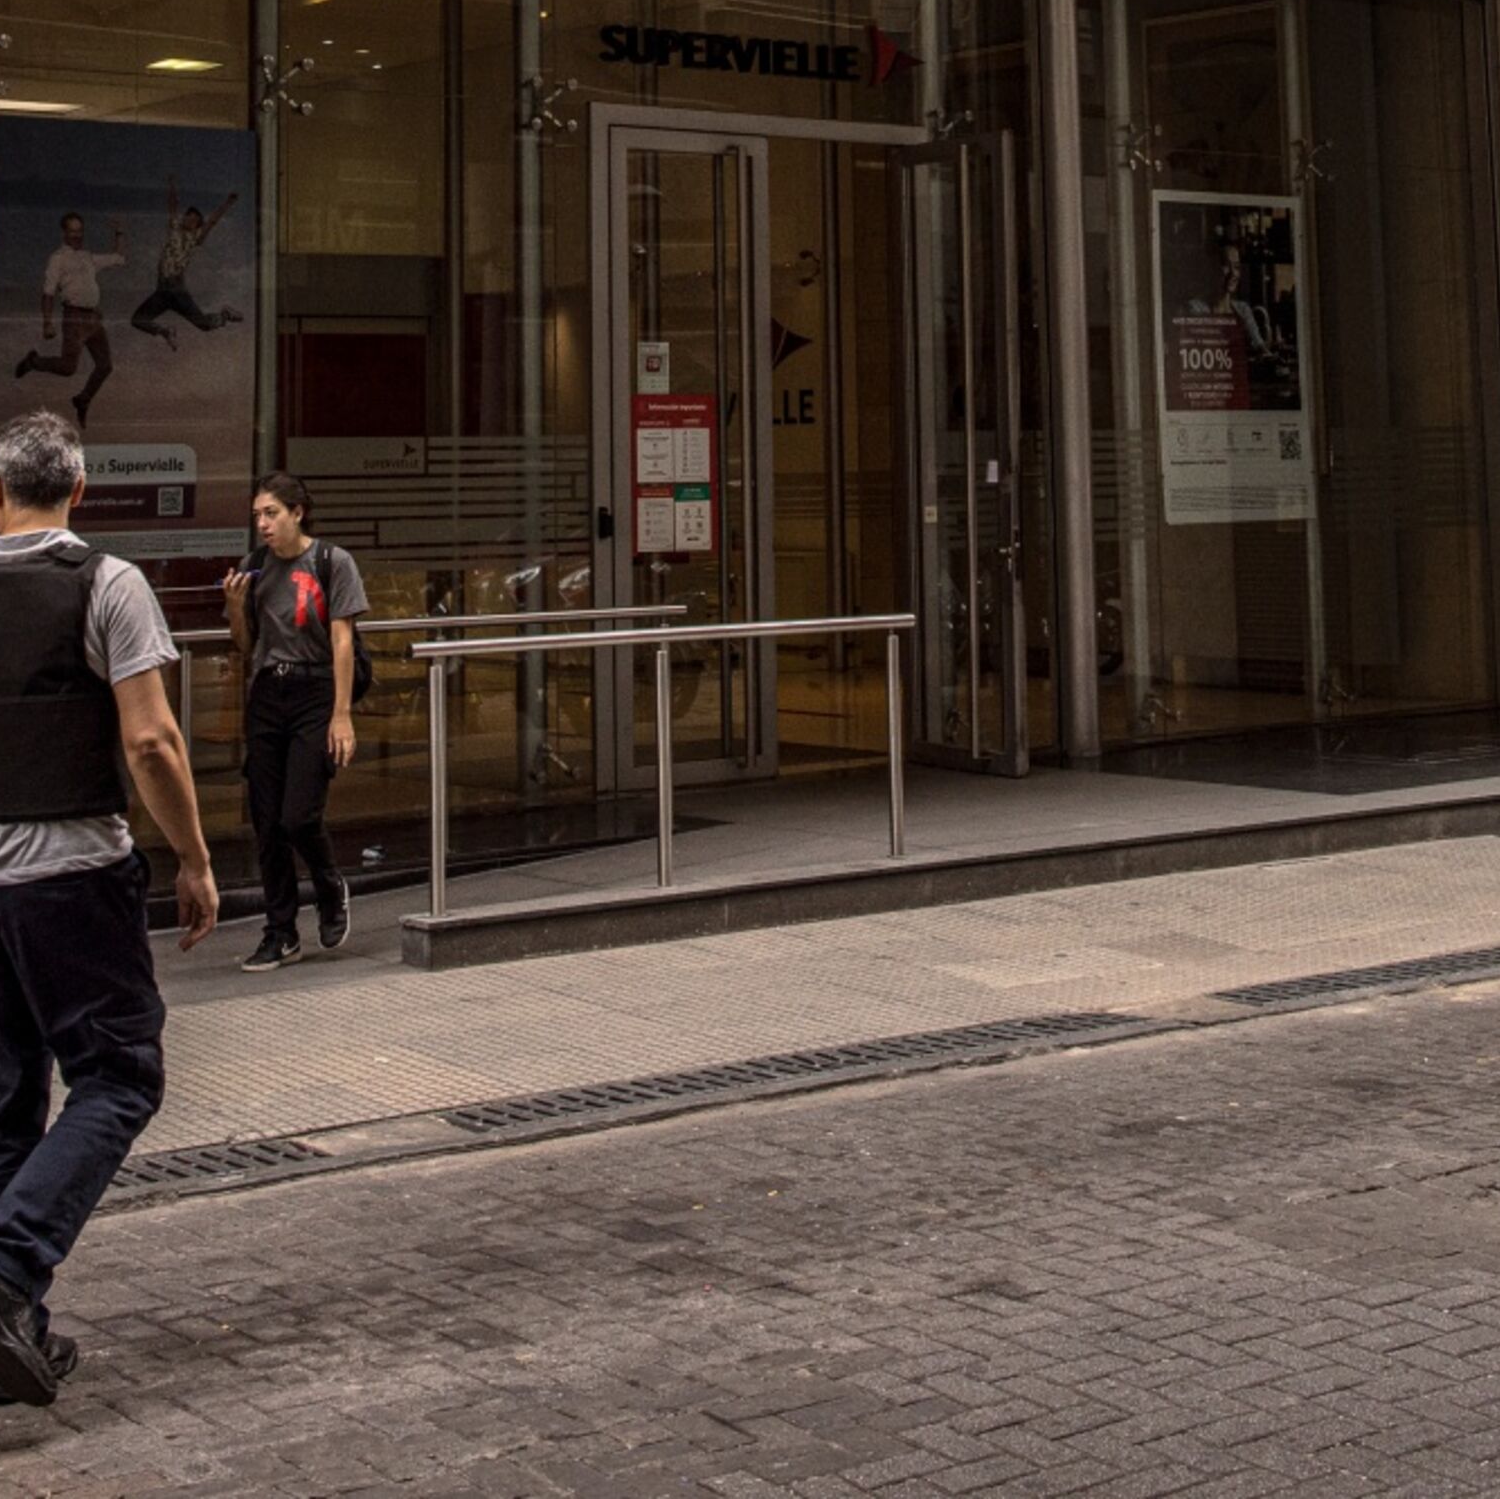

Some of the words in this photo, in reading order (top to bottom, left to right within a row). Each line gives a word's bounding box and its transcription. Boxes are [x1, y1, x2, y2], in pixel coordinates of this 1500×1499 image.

[599, 23, 862, 80] SUPERVIELLE
[1179, 347, 1232, 370] 100%
[108, 457, 185, 476] Supervielle
